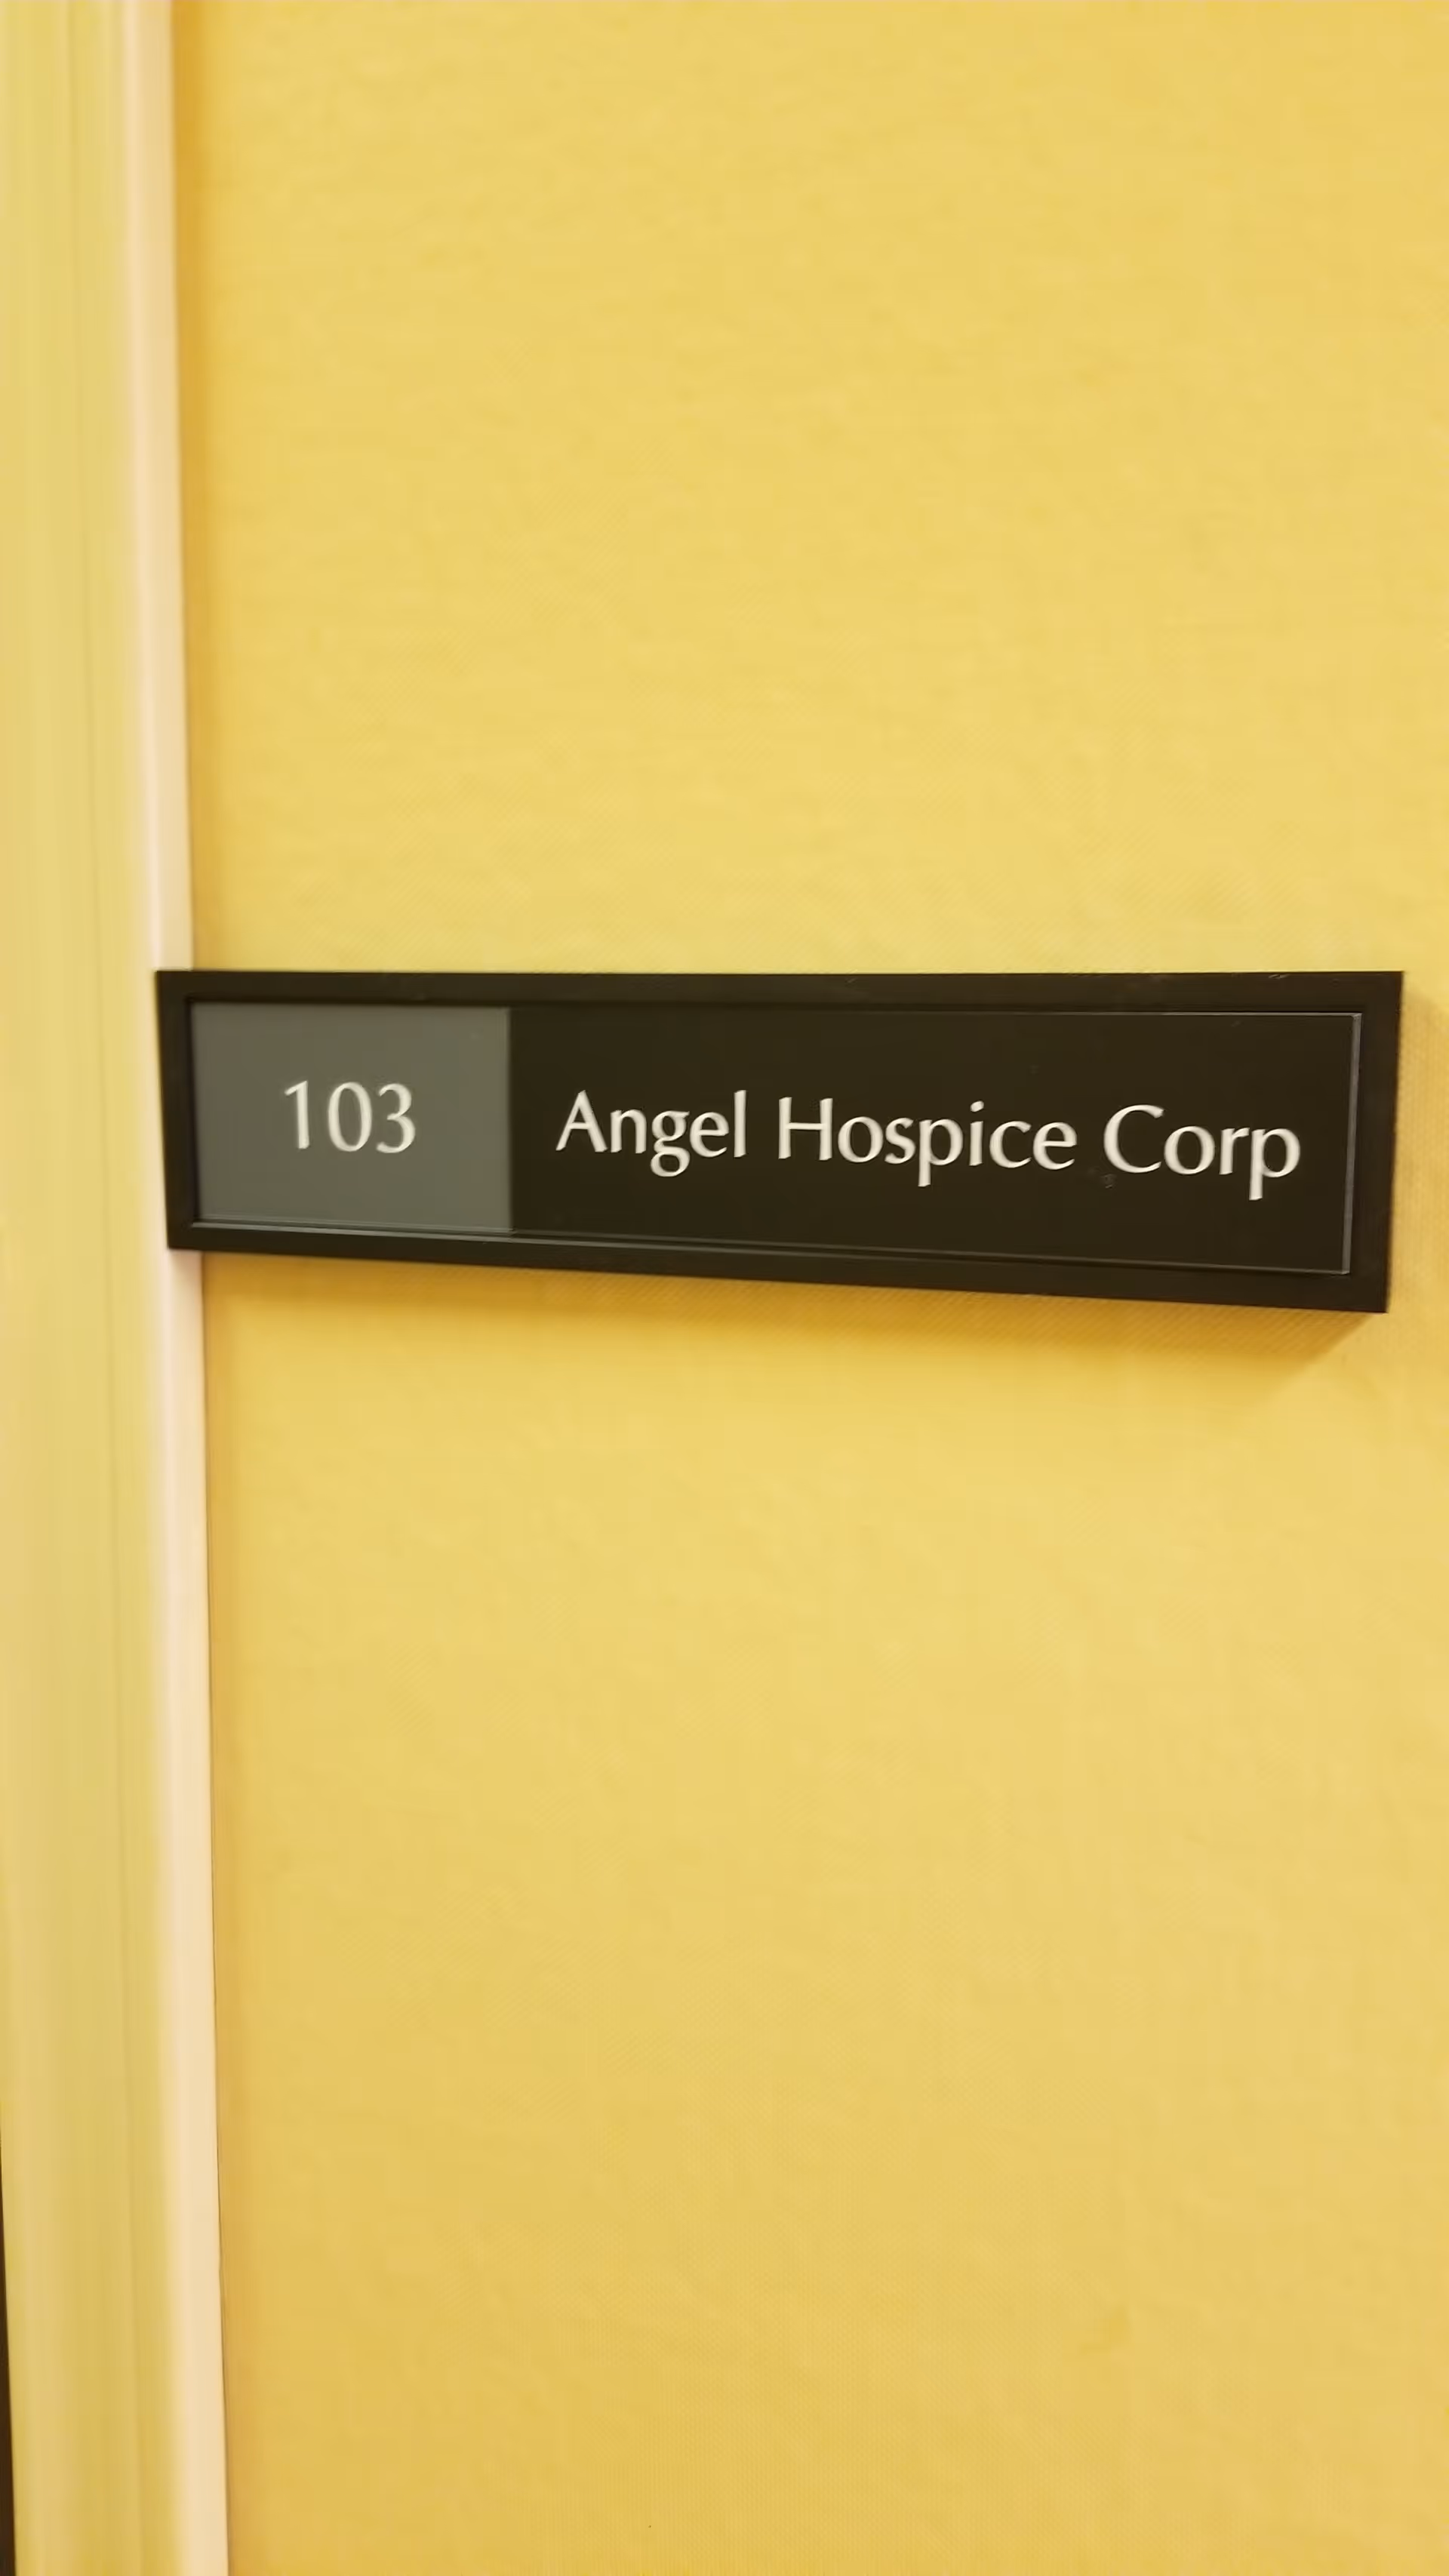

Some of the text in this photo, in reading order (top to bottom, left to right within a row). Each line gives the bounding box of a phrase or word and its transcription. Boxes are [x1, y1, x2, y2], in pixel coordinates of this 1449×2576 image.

[284, 1079, 417, 1155] 103
[555, 1089, 1301, 1201] Angel Hospice Corp
